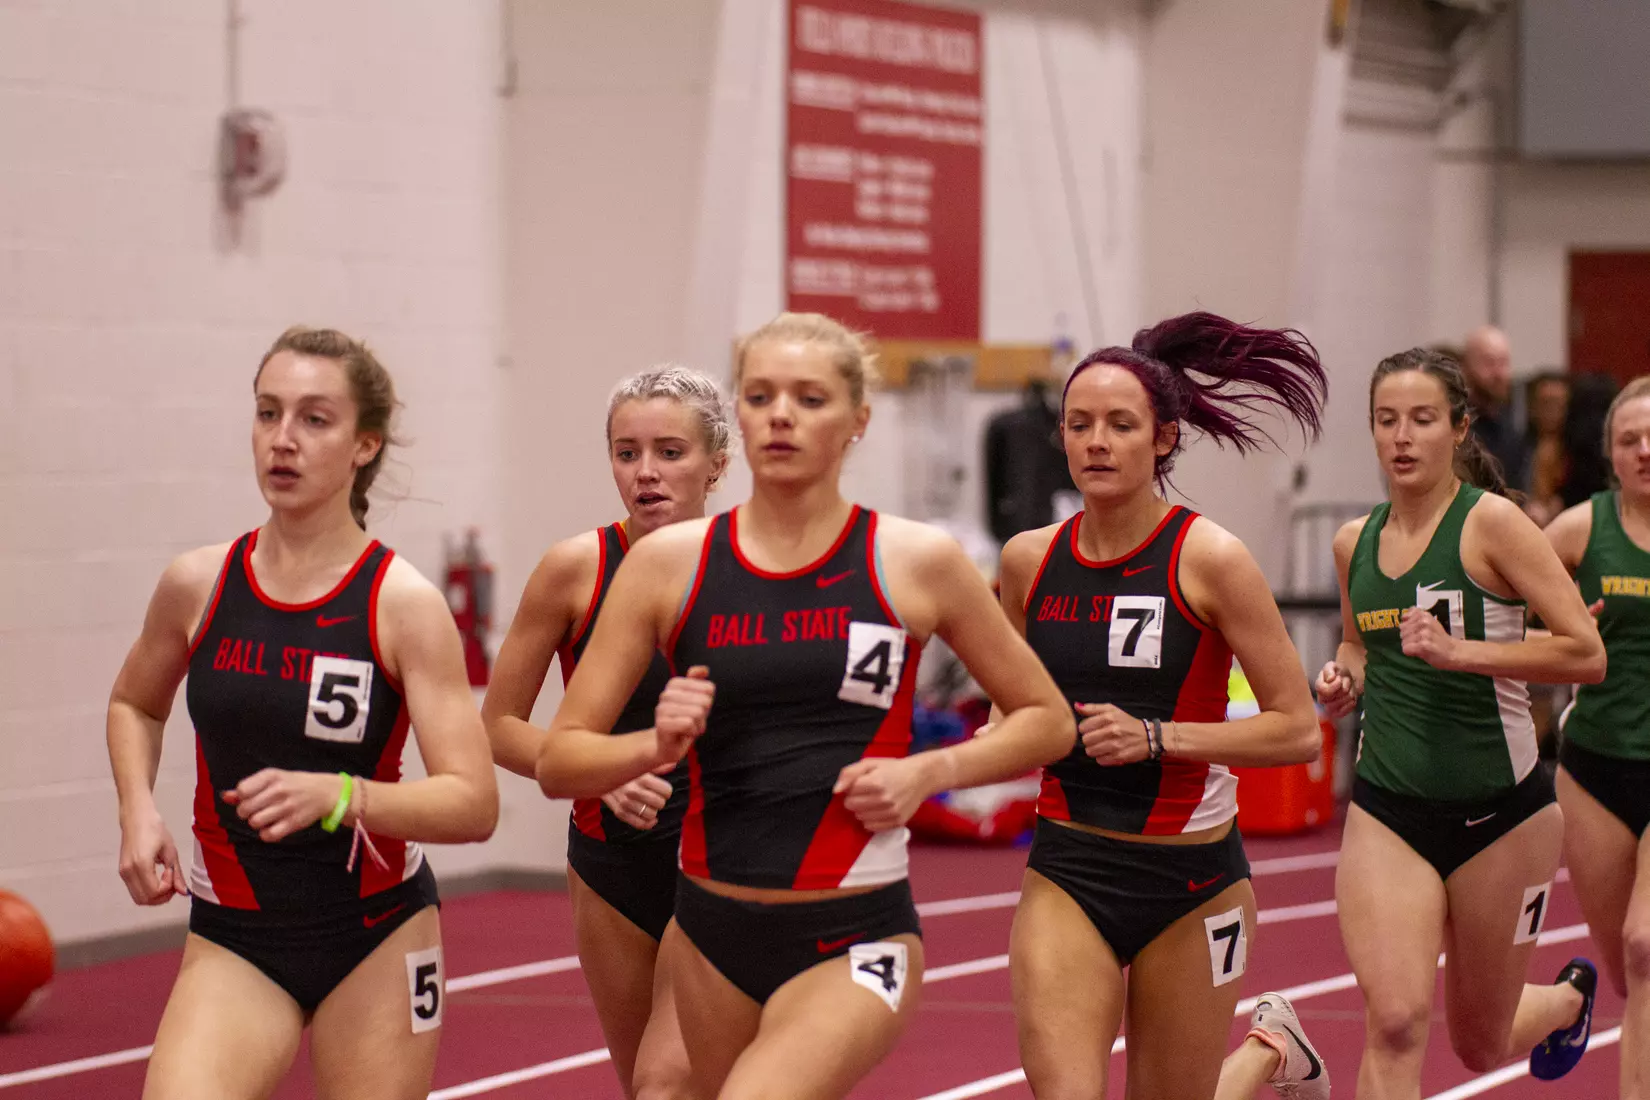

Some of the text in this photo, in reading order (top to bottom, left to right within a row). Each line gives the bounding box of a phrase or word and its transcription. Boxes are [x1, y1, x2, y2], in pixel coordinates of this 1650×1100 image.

[707, 606, 852, 648] BALL STATE
[1037, 596, 1079, 622] BALL
[1357, 608, 1399, 632] WRIGHT
[1116, 608, 1155, 656] 7
[213, 637, 268, 675] BALL
[851, 639, 892, 694] 4
[313, 672, 360, 729] 5
[1525, 891, 1545, 935] 1
[1212, 921, 1240, 974] 7
[414, 962, 438, 1020] 5
[858, 955, 897, 992] 4
